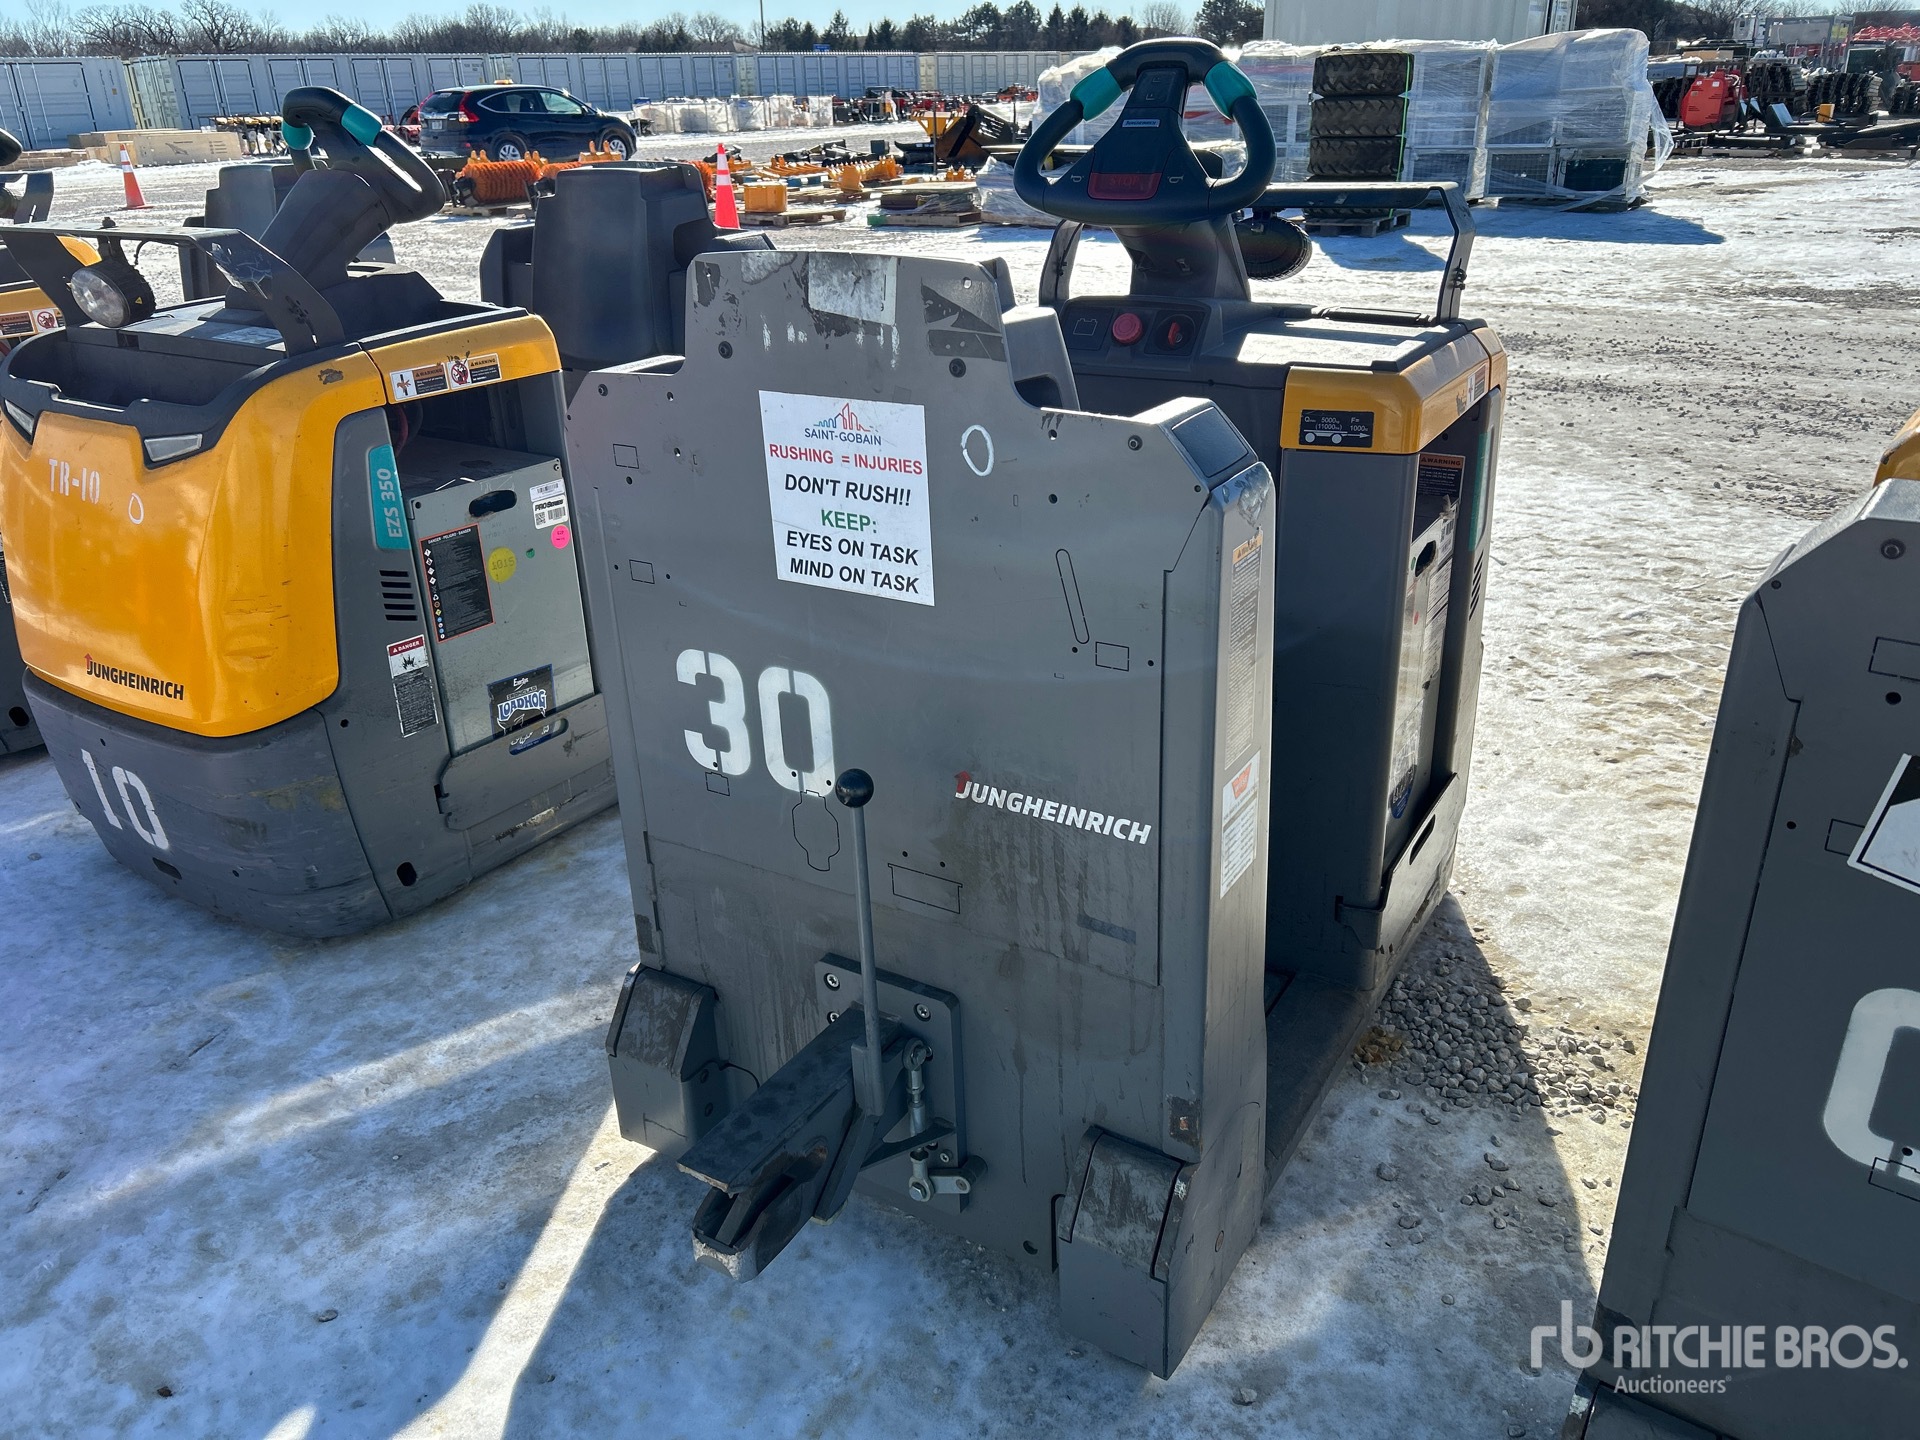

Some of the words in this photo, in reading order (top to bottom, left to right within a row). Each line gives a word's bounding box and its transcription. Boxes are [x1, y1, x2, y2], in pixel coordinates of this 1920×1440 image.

[804, 428, 882, 446] SAINT-GOBAIN
[769, 443, 834, 464] RUSHING
[854, 453, 923, 475] INJURIES
[1429, 457, 1461, 466] WARNING
[48, 458, 100, 505] TR-10
[376, 468, 396, 501] 350
[785, 474, 841, 497] DON'T
[845, 481, 911, 506] RUSH!!
[383, 507, 403, 538] EZS
[821, 509, 877, 533] KEEP:
[786, 530, 832, 552] EYES
[838, 538, 864, 557] ON
[870, 543, 919, 566] TASK
[790, 557, 834, 579] MIND
[839, 566, 865, 585] ON
[871, 571, 919, 594] TASK
[398, 641, 420, 652] DANGER
[86, 660, 184, 701] JUNGHEINRICH
[497, 689, 547, 721] LOADHOG
[676, 648, 836, 797] 30
[81, 748, 169, 850] 10
[955, 780, 1151, 845] JUNGHEINRICH
